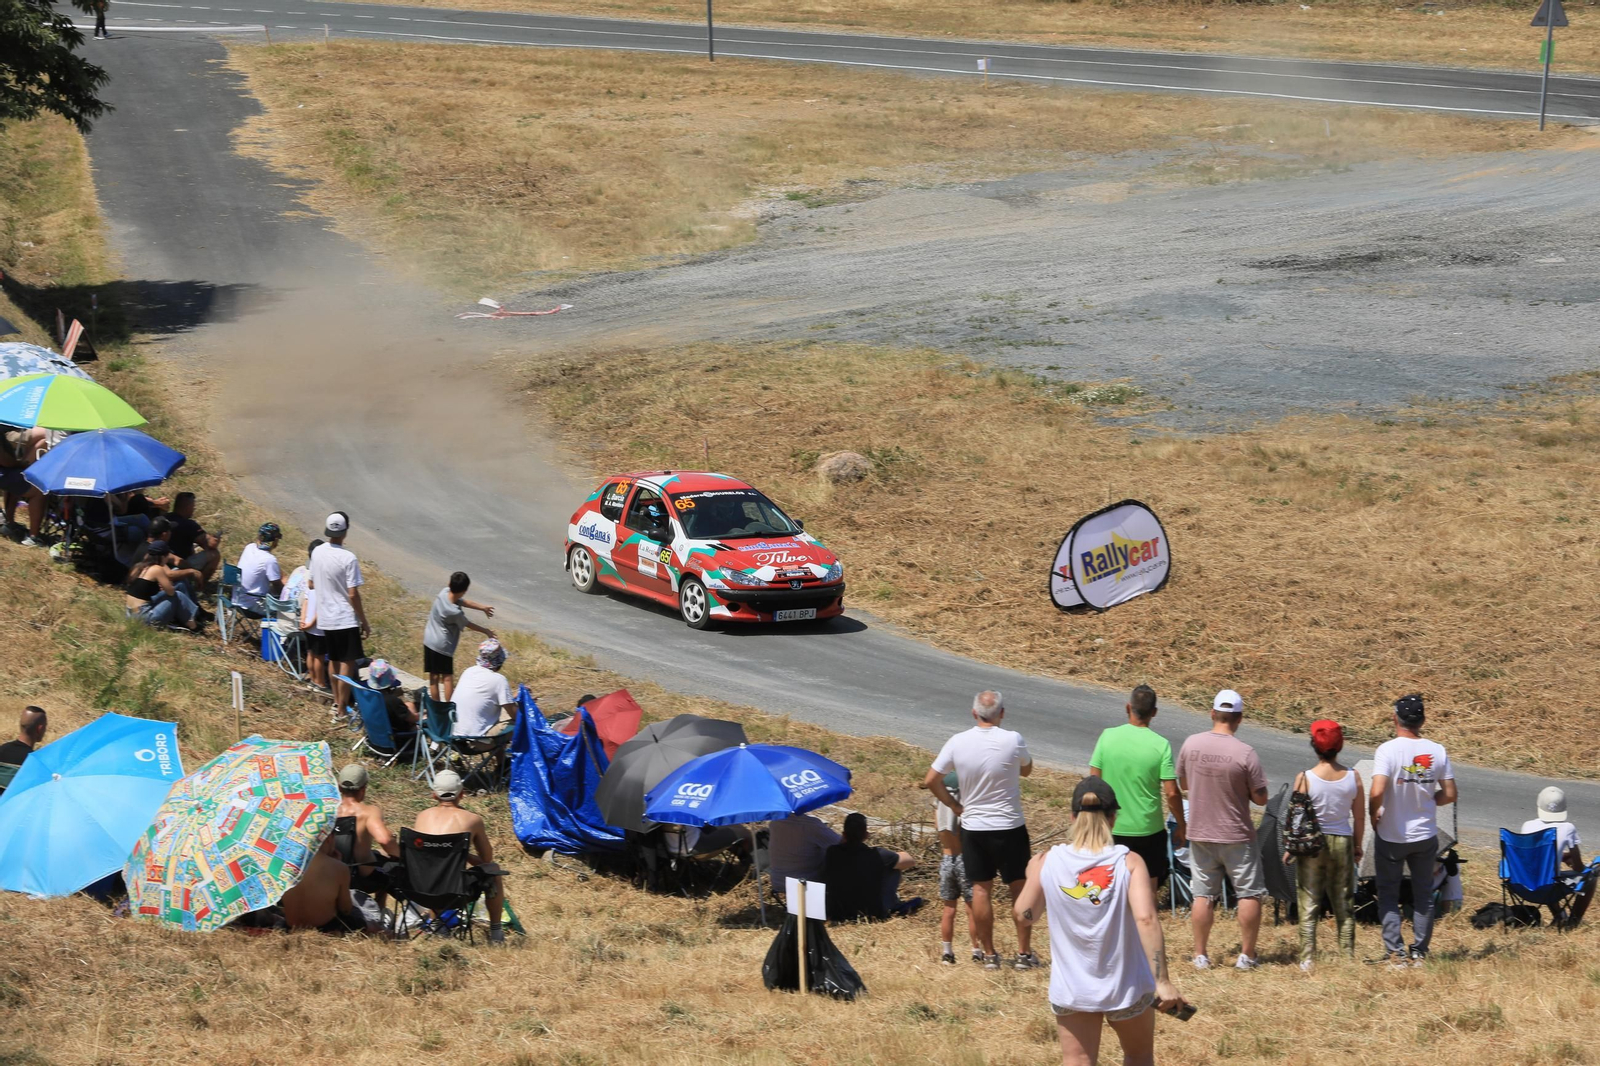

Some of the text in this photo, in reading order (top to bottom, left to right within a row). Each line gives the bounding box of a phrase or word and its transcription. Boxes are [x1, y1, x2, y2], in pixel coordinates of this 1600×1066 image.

[615, 480, 631, 494] 65
[674, 498, 696, 510] 65
[660, 549, 671, 564] 65
[1080, 536, 1160, 577] Rallycar
[799, 610, 815, 619] BPJ
[155, 733, 174, 776] TRIBORD
[1200, 753, 1233, 765] ganso
[780, 769, 822, 789] CGA
[678, 782, 713, 798] CGA
